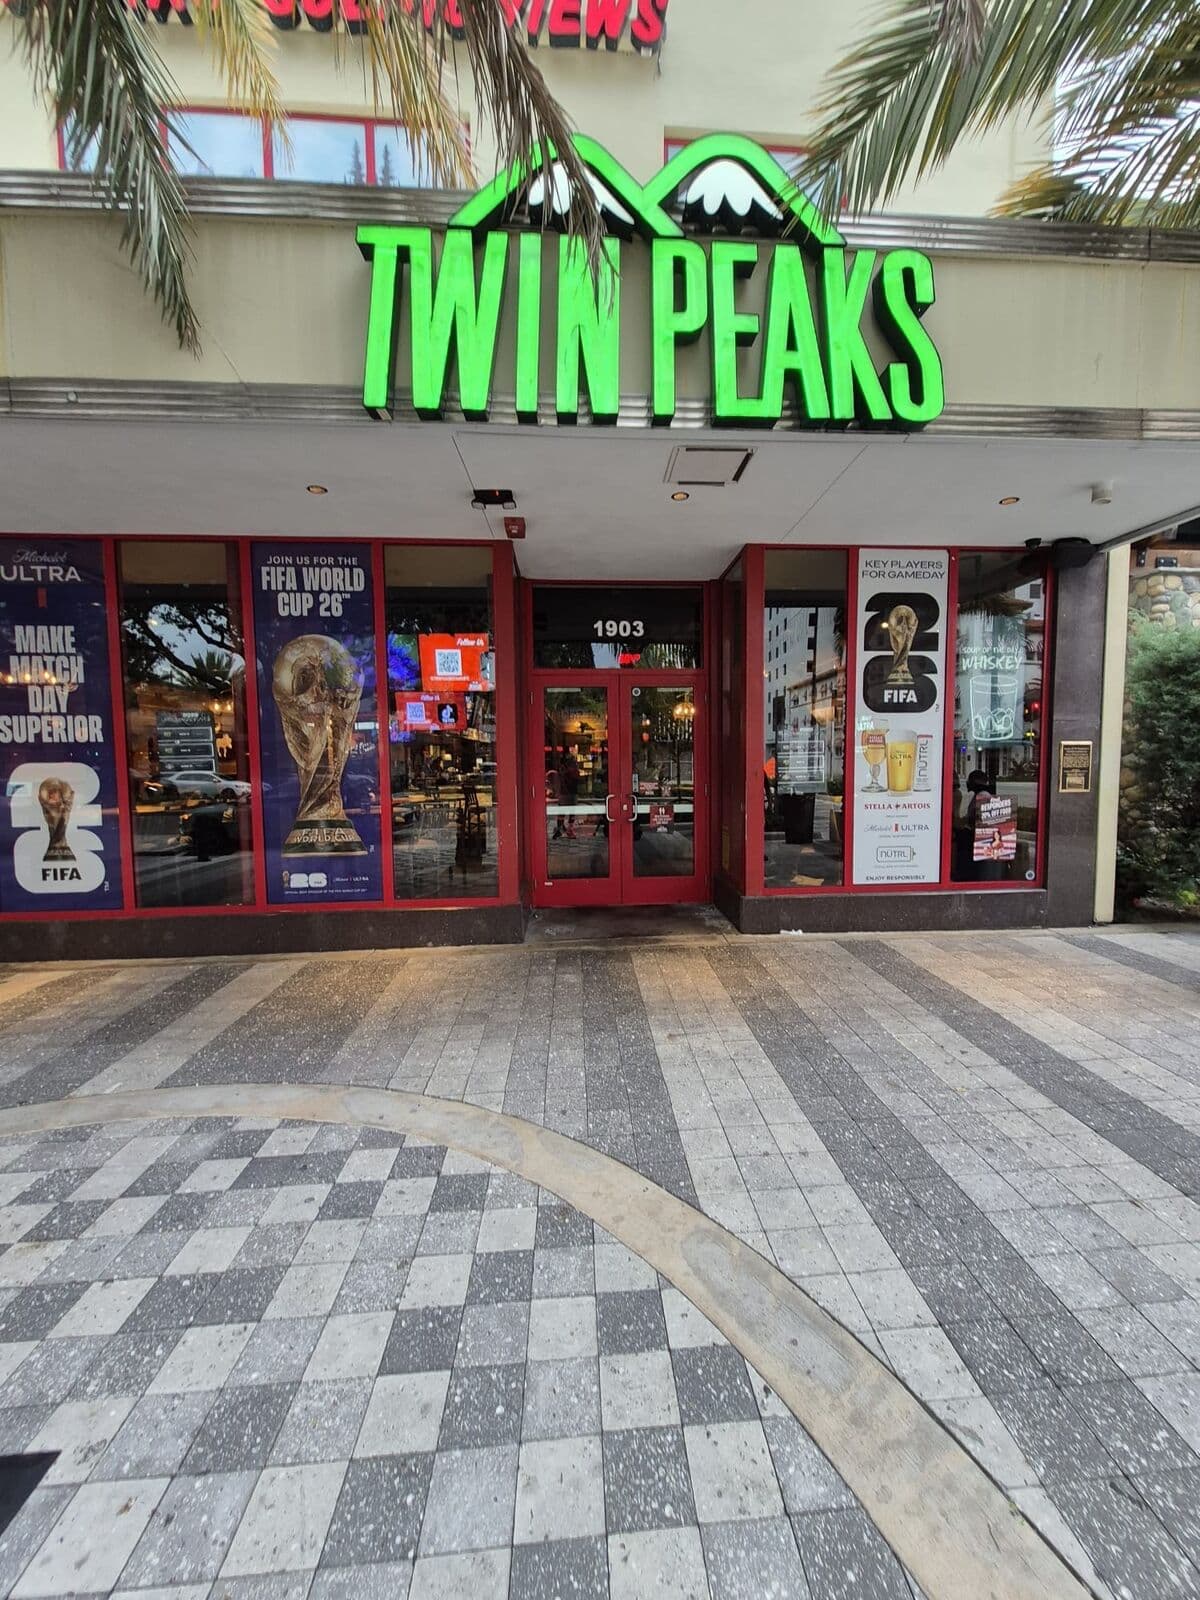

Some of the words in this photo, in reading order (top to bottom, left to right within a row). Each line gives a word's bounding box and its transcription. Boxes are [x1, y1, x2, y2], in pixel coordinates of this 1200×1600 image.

[356, 225, 621, 421] TWIN
[652, 239, 946, 427] PEAKS
[267, 556, 292, 564] JOIN
[296, 556, 310, 564] US
[313, 557, 334, 565] FOR
[337, 557, 358, 565] THE
[865, 560, 889, 569] KEY
[890, 560, 943, 569] PLAYERS
[0, 565, 81, 582] ULTRA
[261, 566, 298, 591] FIFA
[302, 567, 365, 592] WORLD
[861, 570, 886, 579] FOR
[887, 570, 946, 579] GAMEDAY
[277, 592, 314, 617] CUP
[593, 620, 645, 637] 1903
[14, 625, 77, 653] MAKE
[9, 655, 85, 683] MATCH
[962, 654, 1023, 671] WHISKEY
[27, 684, 69, 713] DAY
[883, 689, 918, 703] FIFA
[0, 714, 104, 743] SUPERIOR
[864, 803, 893, 811] STELLA
[902, 802, 931, 810] ARTOIS
[901, 824, 930, 832] ULTRA
[42, 868, 82, 881] FIFA
